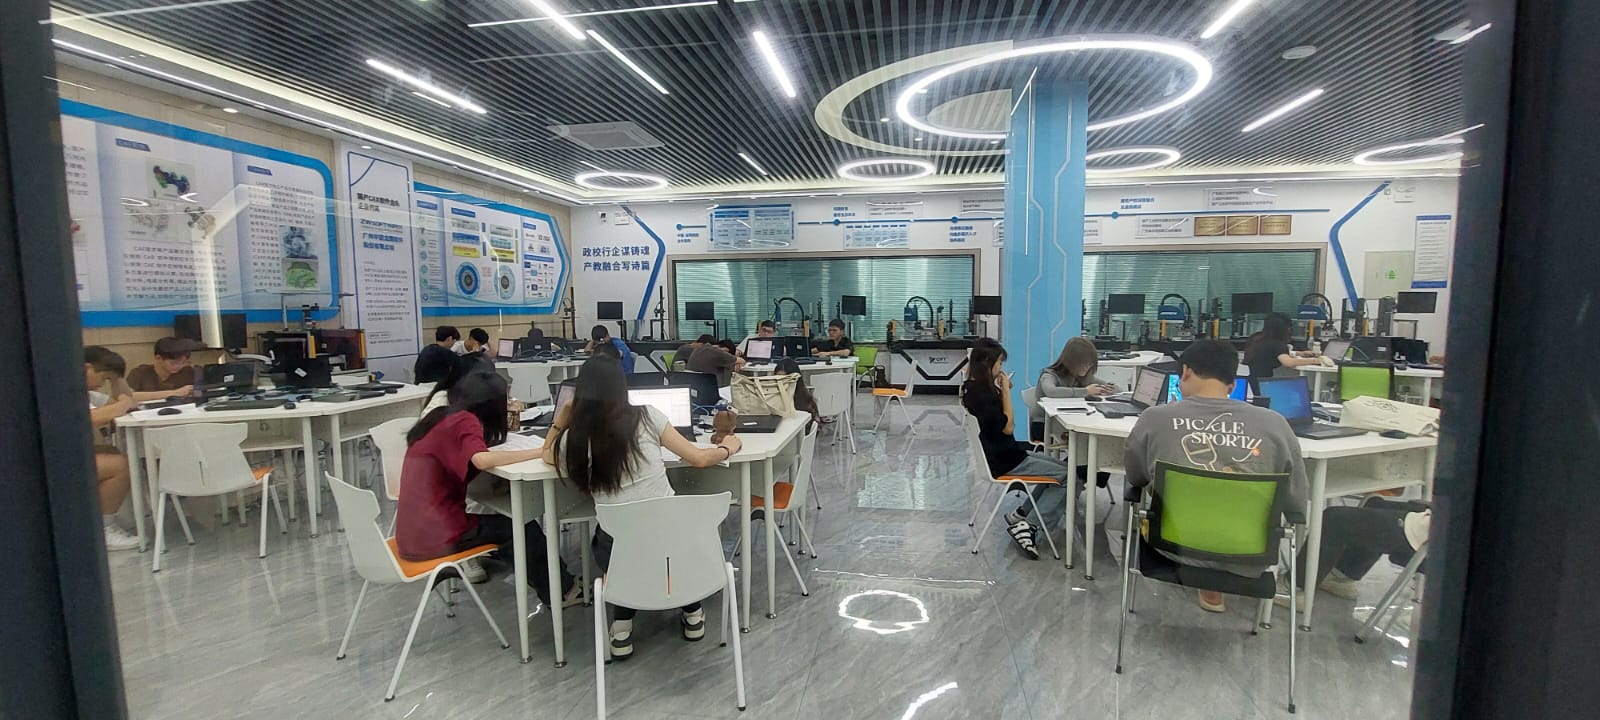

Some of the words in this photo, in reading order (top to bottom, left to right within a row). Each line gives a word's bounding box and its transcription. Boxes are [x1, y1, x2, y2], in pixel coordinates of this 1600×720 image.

[582, 245, 650, 258] 政校行企谋铸魂
[583, 260, 650, 272] 产教融合写诗篇
